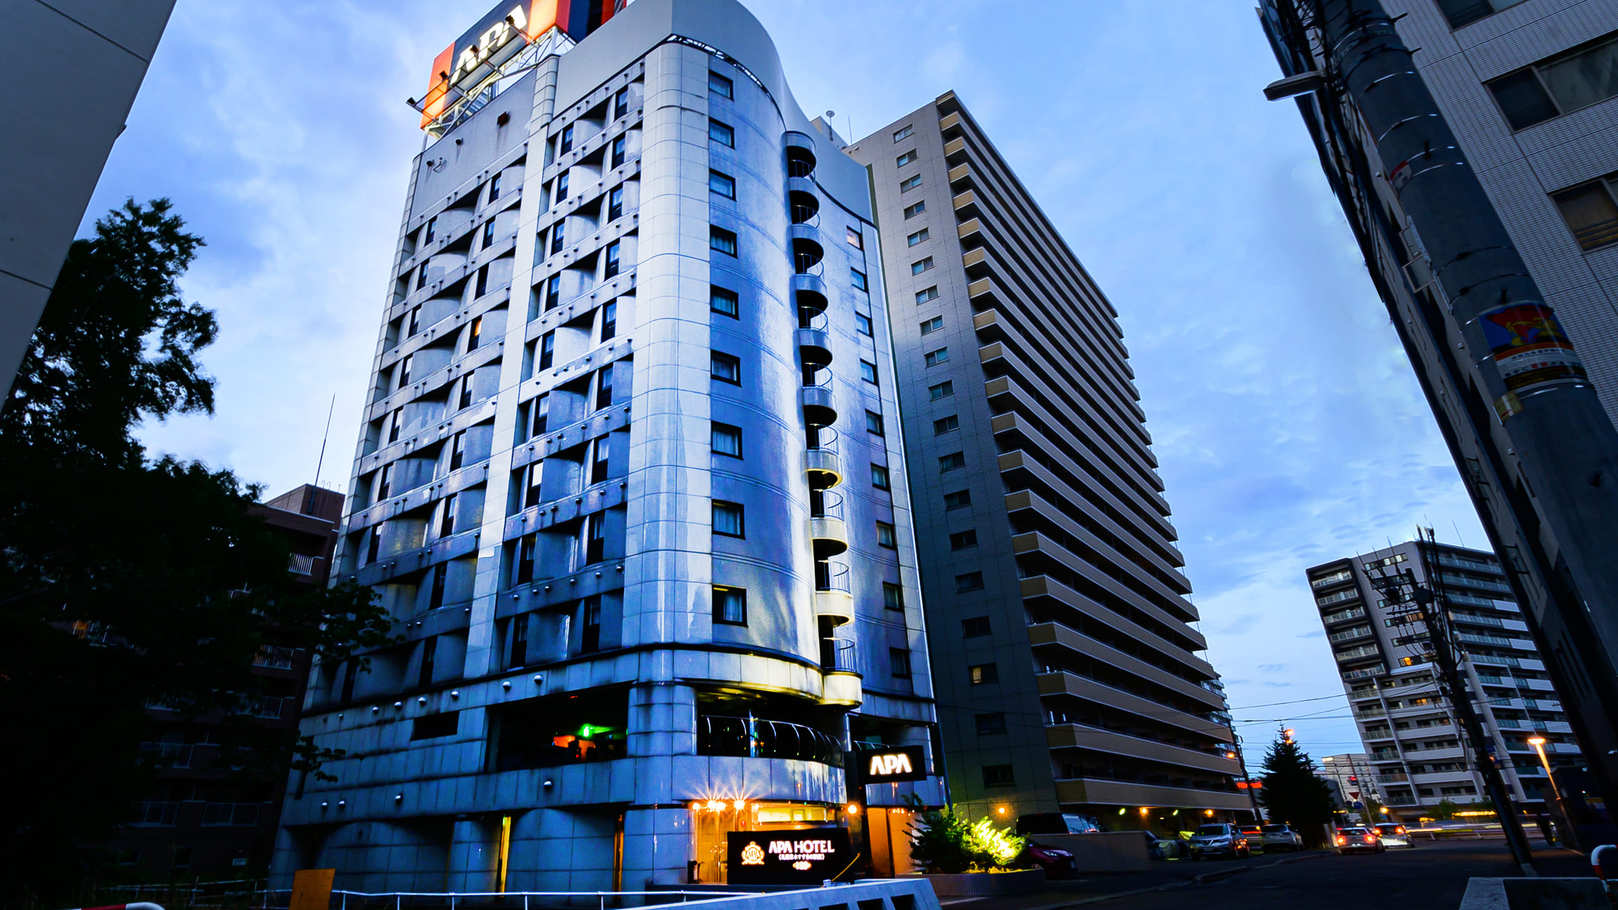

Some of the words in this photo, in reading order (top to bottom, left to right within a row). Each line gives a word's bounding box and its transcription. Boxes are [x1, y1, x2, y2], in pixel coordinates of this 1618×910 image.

[450, 4, 527, 87] APA
[870, 753, 912, 775] APA
[768, 841, 793, 854] APA
[793, 840, 835, 853] HOTEL
